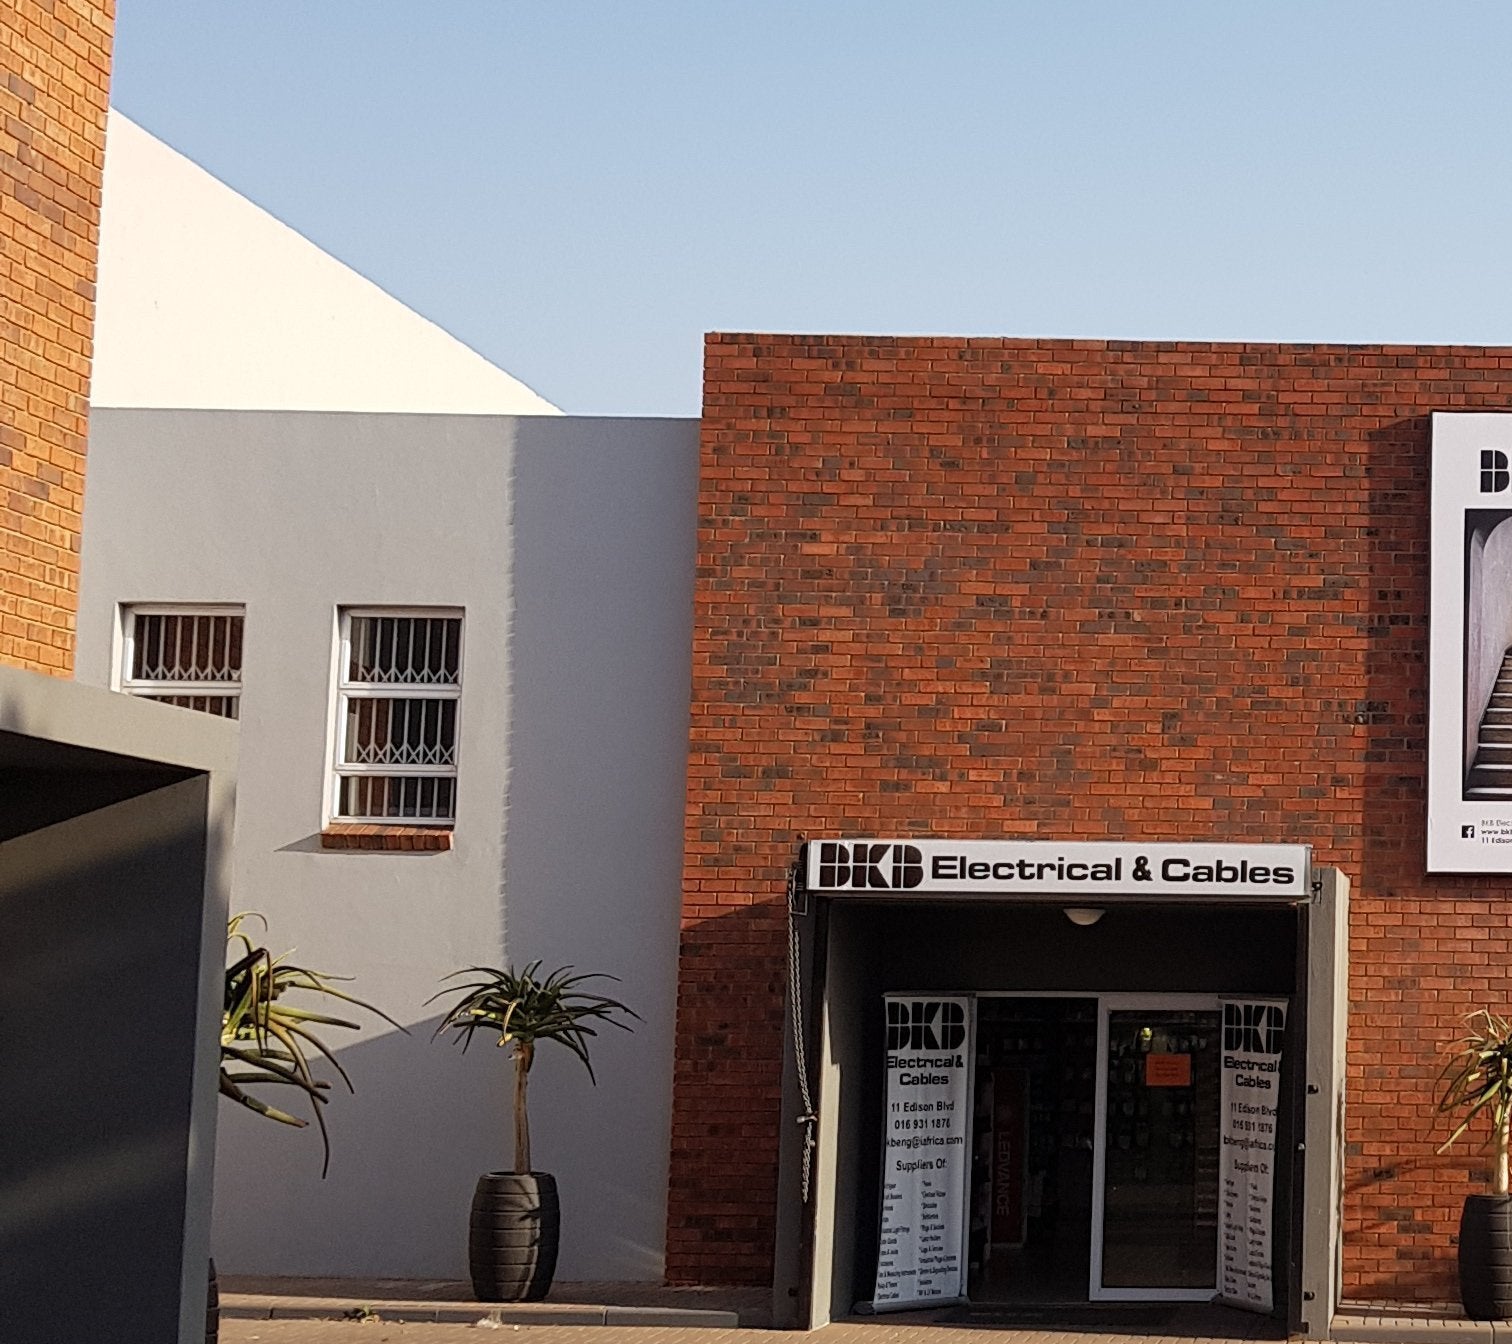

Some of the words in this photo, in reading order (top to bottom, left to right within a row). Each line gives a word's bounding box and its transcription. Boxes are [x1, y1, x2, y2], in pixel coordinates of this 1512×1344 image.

[819, 842, 924, 889] BKB
[932, 855, 1122, 883] Electrical
[1132, 857, 1153, 883] &
[1161, 858, 1295, 886] Cables
[887, 1002, 966, 1051] BKB
[1224, 1003, 1285, 1055] BKB
[886, 1055, 954, 1069] Electrical
[955, 1054, 964, 1068] &
[1224, 1056, 1277, 1073] Electrical
[899, 1072, 949, 1086] Cables
[1235, 1074, 1272, 1090] Cables
[891, 1102, 900, 1112] 11
[903, 1101, 934, 1112] Edison
[936, 1100, 955, 1111] Blvd
[1230, 1102, 1237, 1113] 11
[1238, 1102, 1260, 1114] Edison
[894, 1119, 911, 1130] 016
[913, 1119, 928, 1129] 931
[895, 1158, 934, 1174] Suppliers
